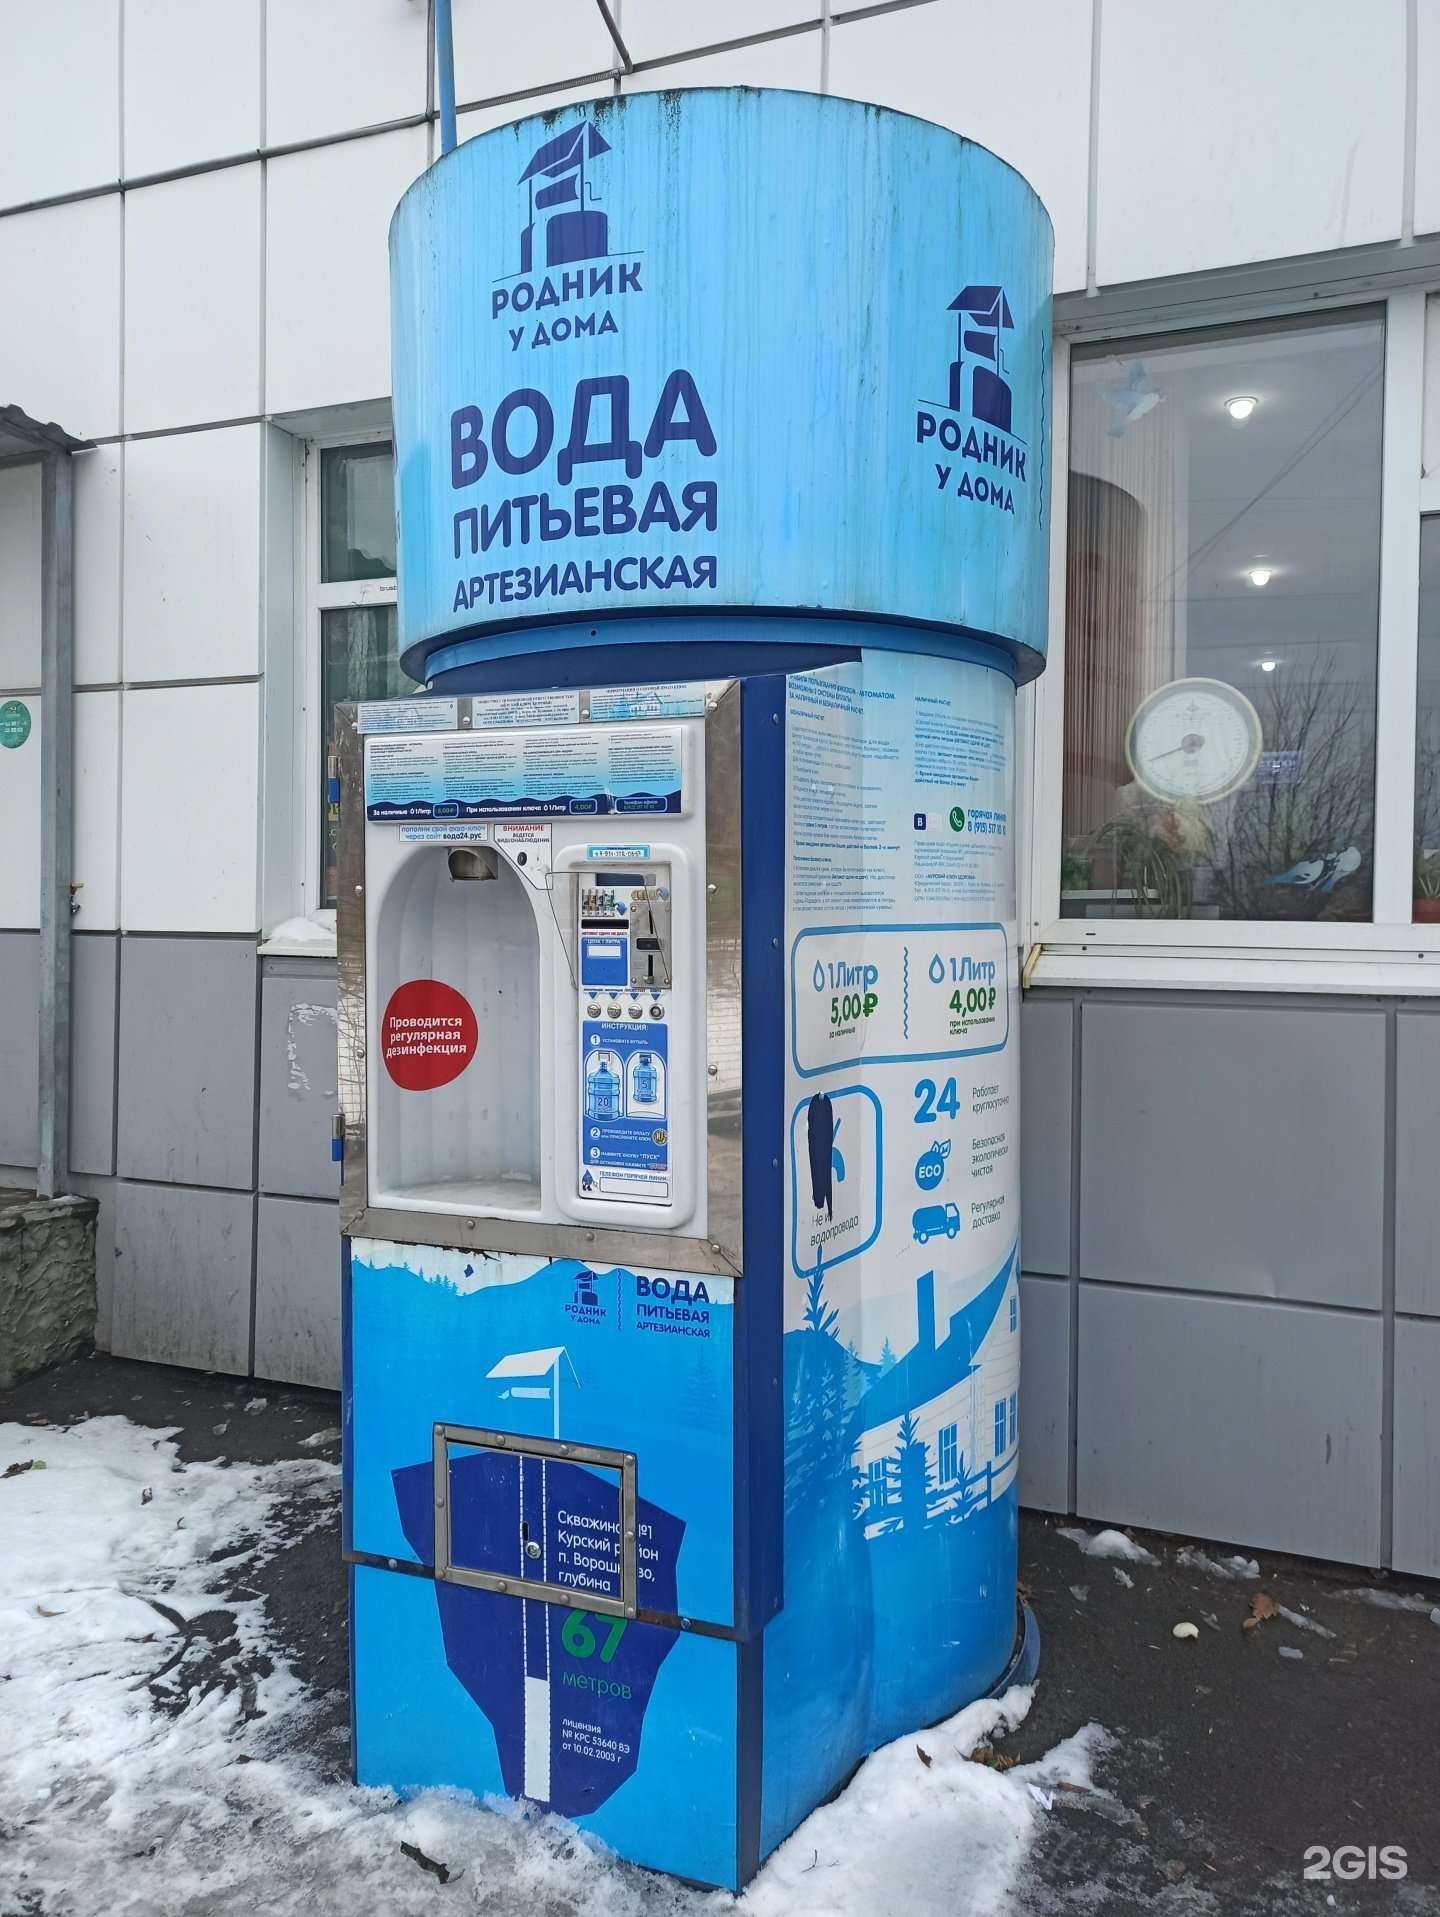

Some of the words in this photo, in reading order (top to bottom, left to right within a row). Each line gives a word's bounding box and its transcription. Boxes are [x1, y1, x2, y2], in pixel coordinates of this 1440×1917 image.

[492, 262, 643, 319] РОДНИК
[508, 328, 525, 352] У
[531, 310, 619, 349] ДОМА
[450, 368, 718, 490] ВОДА
[916, 411, 1026, 482] РОДНИК
[935, 463, 952, 490] У
[957, 471, 1015, 515] ДОМА
[453, 480, 718, 560] ПИТЬЕВАЯ
[453, 555, 718, 613] АРТЕЗИАНСКАЯ
[443, 832, 482, 841] вода24.рус
[503, 824, 544, 832] ВНИМАНИЕ
[389, 1016, 462, 1030] Проводится
[390, 1030, 461, 1045] регулярная
[386, 1043, 467, 1059] дезинфекция
[598, 1097, 609, 1107] 20
[913, 1076, 961, 1124] 24
[592, 1128, 598, 1137] 2
[592, 1148, 598, 1157] 3
[918, 1164, 942, 1179] ECO
[810, 1215, 859, 1247] водопровода
[635, 1275, 710, 1306] ВОДА
[564, 1304, 607, 1317] РОДНИК
[577, 1316, 600, 1325] ДОМА
[636, 1303, 710, 1324] ПИТЬЕВАЯ
[636, 1321, 710, 1338] АРТЕЗИАНСКАЯ
[558, 1529, 611, 1553] Курский
[558, 1551, 570, 1564] п.
[558, 1571, 611, 1592] глубина
[561, 1609, 629, 1664] 67
[562, 1671, 632, 1701] метров
[562, 1718, 602, 1734] лицензия
[562, 1728, 573, 1739] №
[574, 1732, 590, 1744] КРС
[592, 1736, 617, 1750] 53640
[618, 1742, 630, 1754] ВЭ
[562, 1742, 571, 1751] от
[573, 1743, 616, 1762] 10.02.2003
